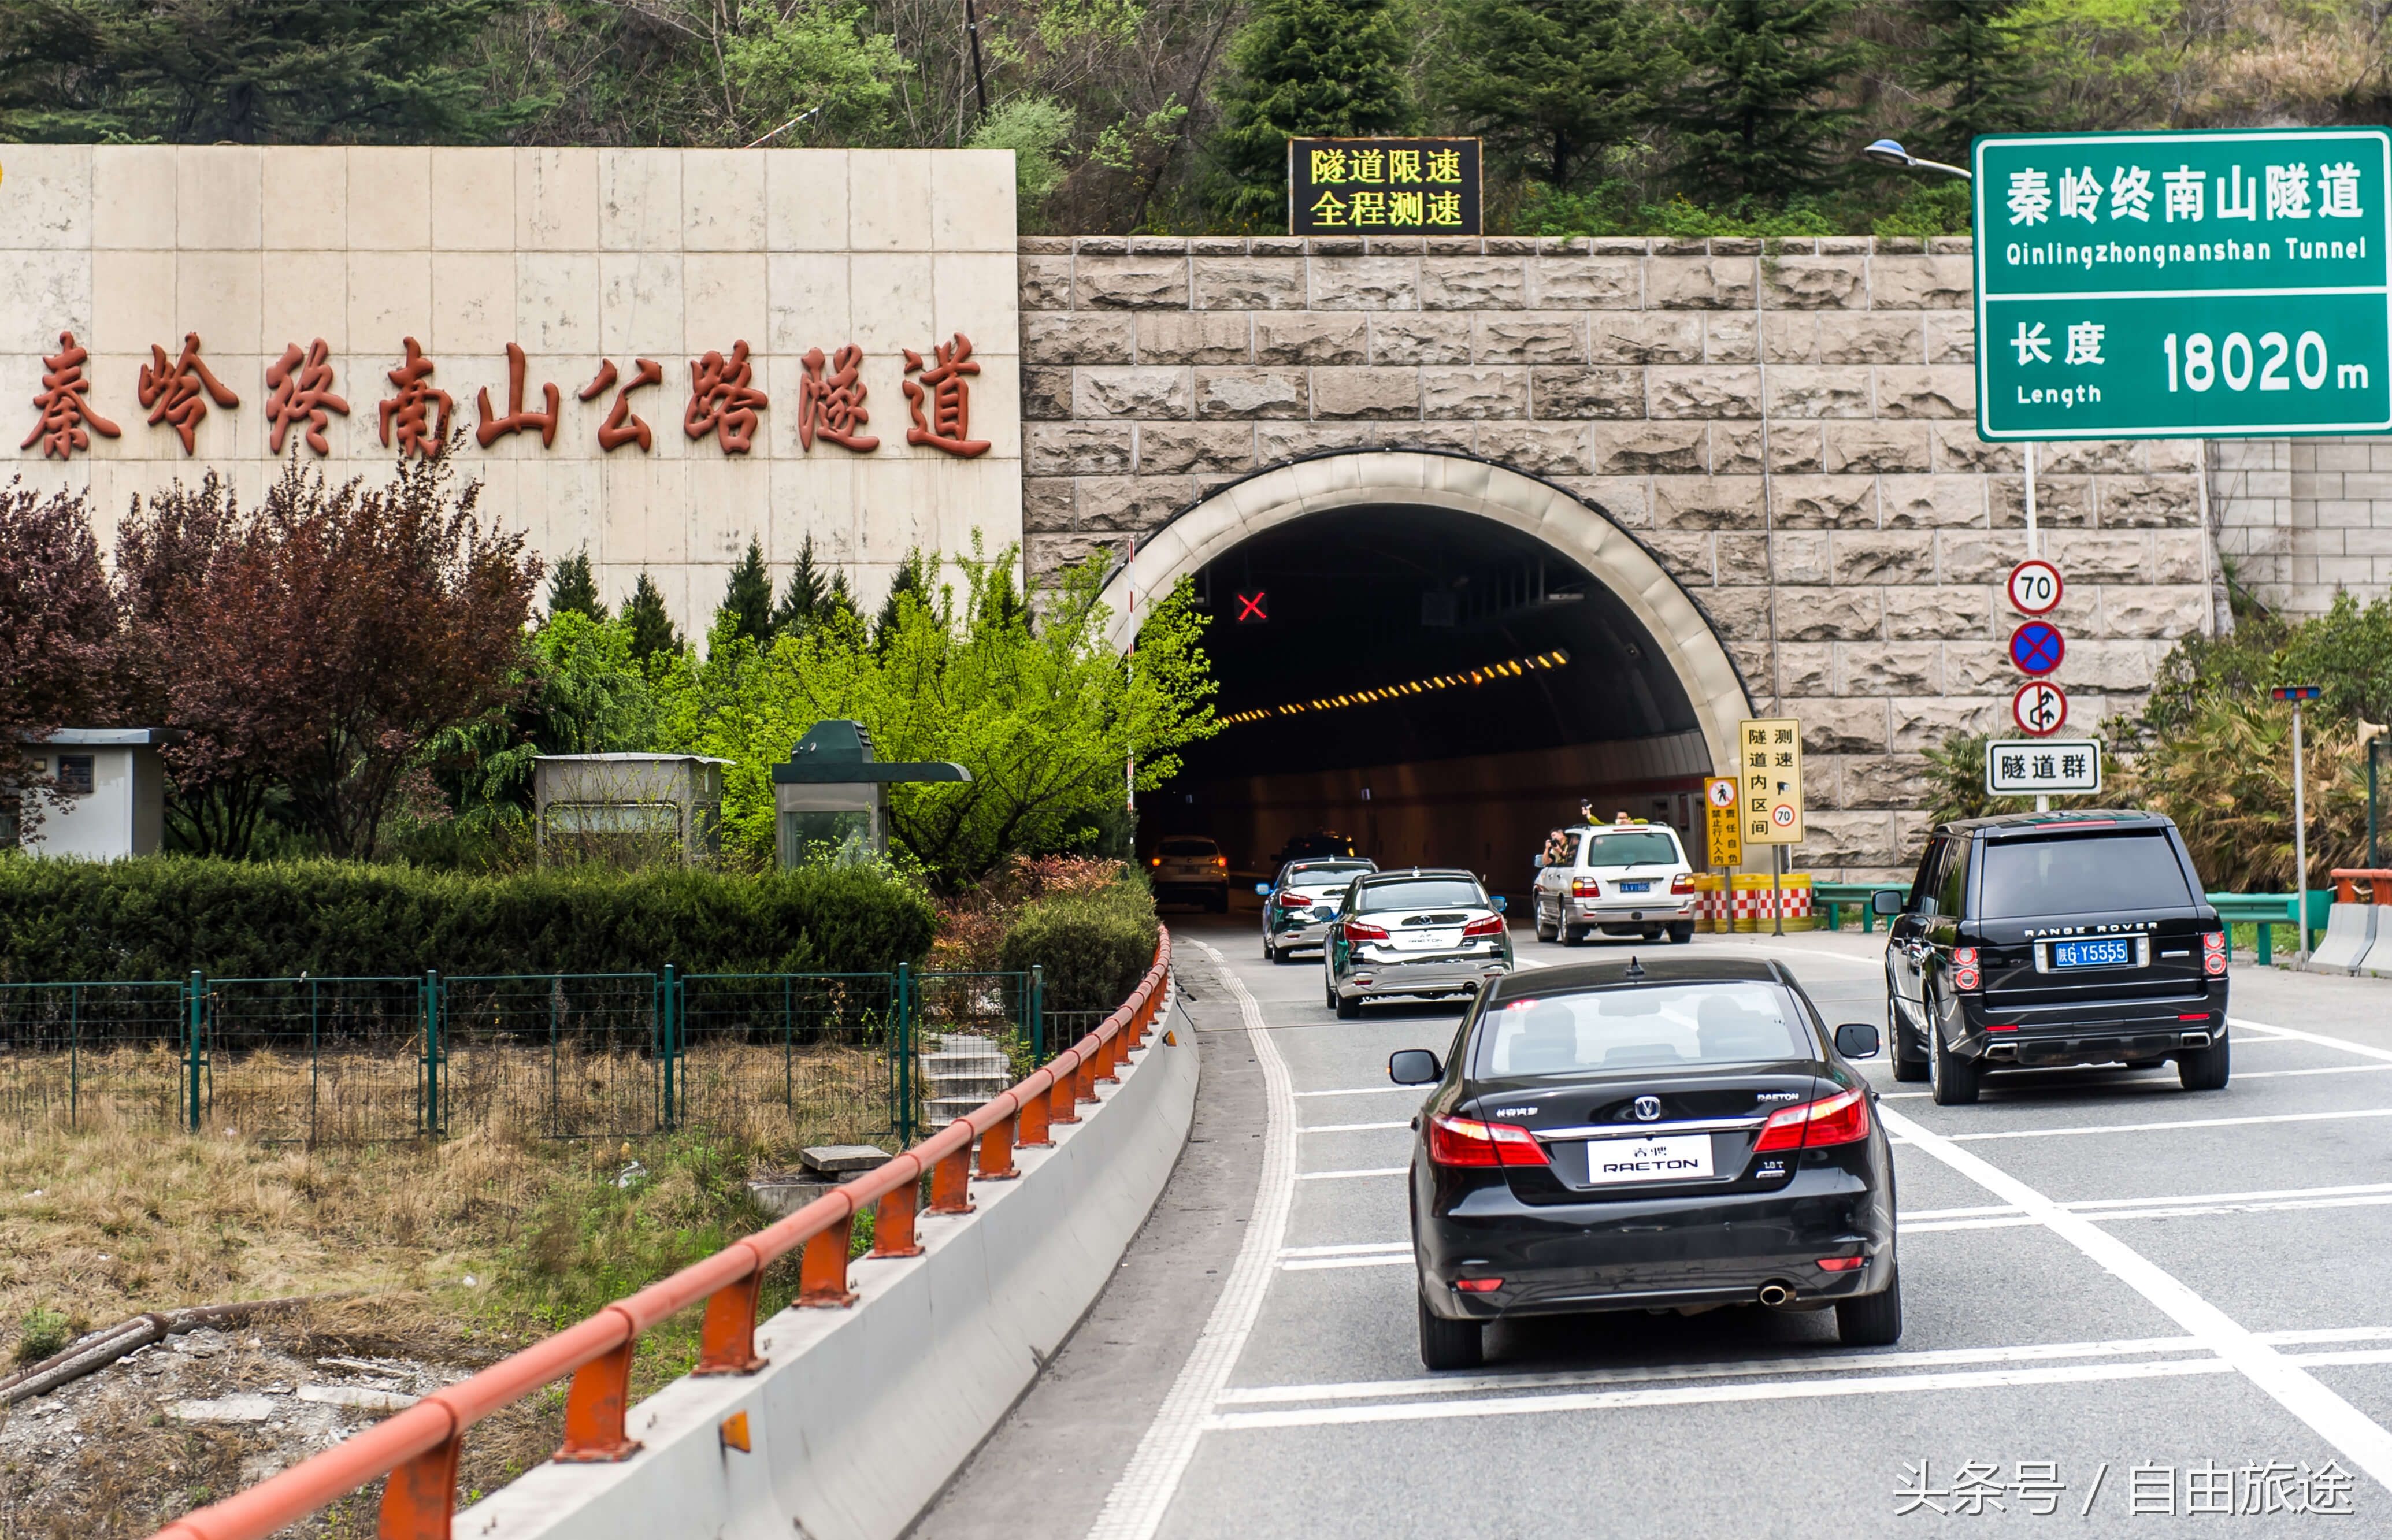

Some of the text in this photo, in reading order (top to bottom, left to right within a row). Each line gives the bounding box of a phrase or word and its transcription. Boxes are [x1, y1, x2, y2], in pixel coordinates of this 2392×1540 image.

[1310, 148, 1463, 185] 隧道限速
[1310, 190, 1463, 227] 全程测速
[2007, 162, 2364, 226] 秦岭终南山隧道
[2007, 236, 2366, 270] Qinlingzhongnanshan Tunnel
[2010, 321, 2105, 366] 长度
[2164, 331, 2369, 392] 18020 m
[2018, 384, 2101, 408] Length
[2020, 576, 2051, 600] 70
[1775, 729, 1793, 767] 测速
[1749, 729, 1768, 835] 隧道内区间
[2002, 754, 2086, 780] 隧道群
[1778, 811, 1790, 821] 70
[1712, 810, 1723, 863] 禁止行人入内
[2024, 922, 2158, 937] RANGE ROVER
[1604, 1159, 1698, 1172] RAETON
